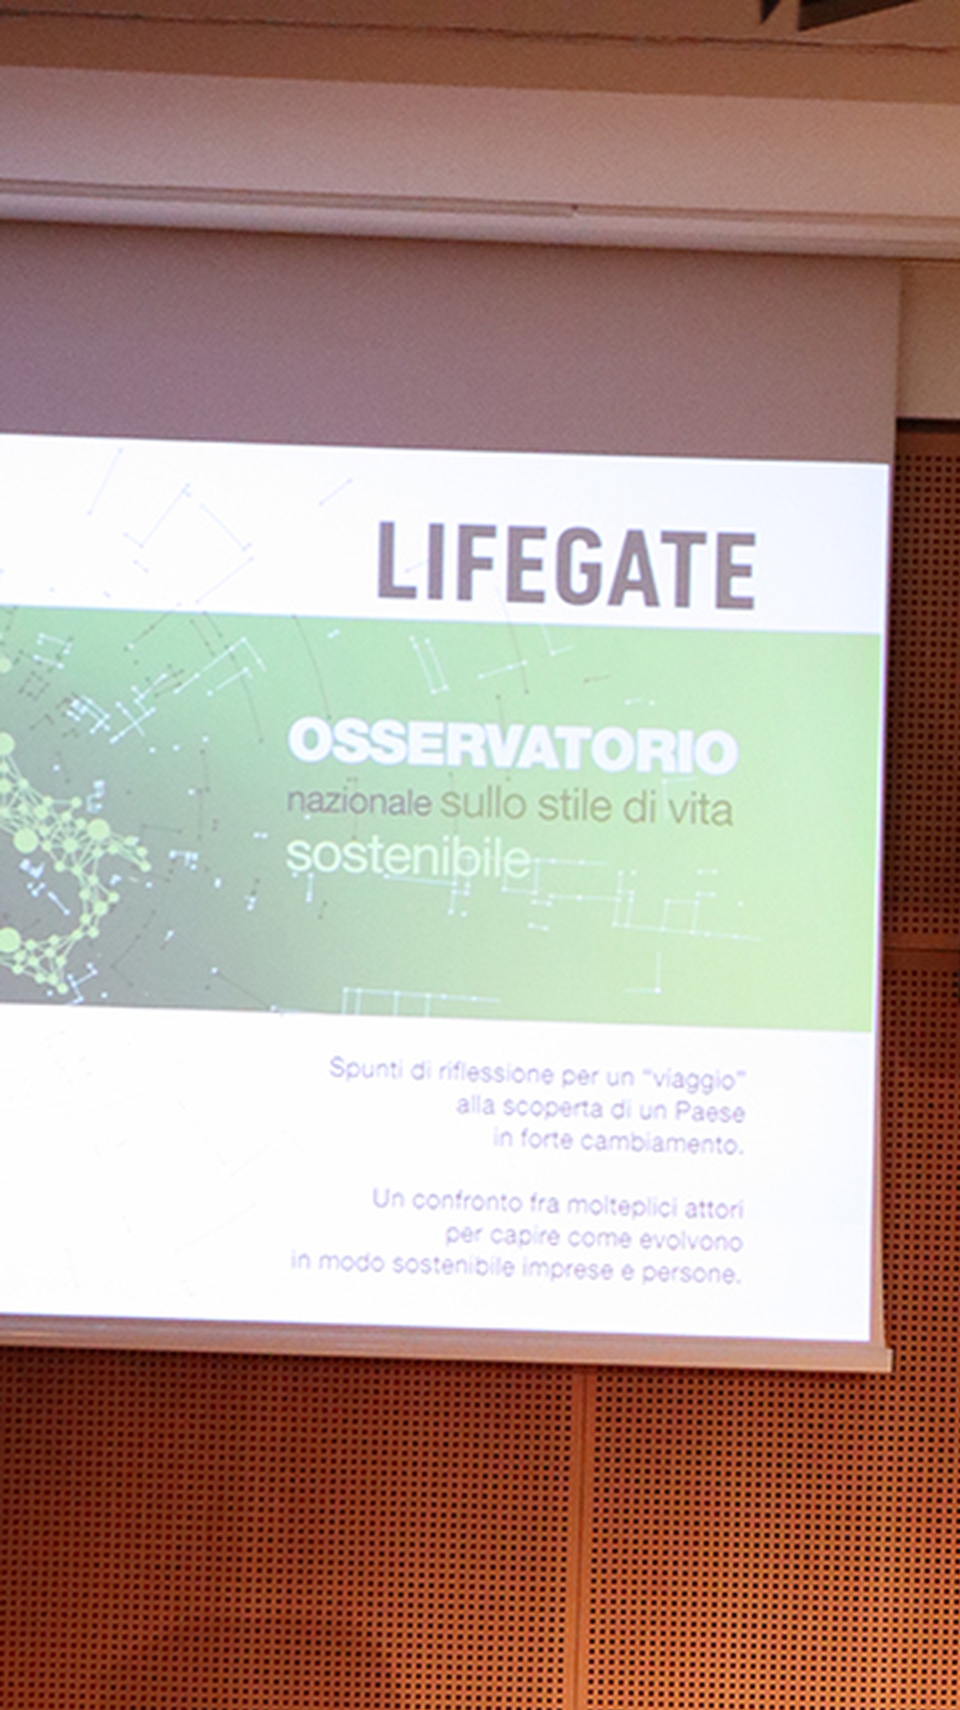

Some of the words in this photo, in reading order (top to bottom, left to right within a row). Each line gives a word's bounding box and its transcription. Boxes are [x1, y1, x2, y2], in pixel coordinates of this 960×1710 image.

[377, 521, 757, 611] LIFEGATE
[287, 716, 740, 776] OSSERVATORIO
[287, 788, 432, 817] nazionale
[440, 785, 527, 819] sullo
[537, 788, 612, 822] stile
[624, 792, 657, 824] di
[667, 792, 733, 827] vita
[286, 833, 531, 879] sostenibile
[329, 1056, 403, 1082] Spunti
[410, 1060, 432, 1082] di
[438, 1062, 554, 1085] riflessione
[561, 1067, 599, 1088] per
[606, 1068, 635, 1088] un
[456, 1095, 496, 1115] alla
[502, 1097, 603, 1120] scoperta
[611, 1100, 631, 1120] di
[639, 1102, 667, 1122] un
[675, 1099, 746, 1124] Paese
[493, 1128, 513, 1148] in
[520, 1129, 574, 1151] forte
[581, 1131, 745, 1156] cambiamento.
[372, 1188, 405, 1210] Un
[412, 1190, 523, 1212] confronto
[530, 1193, 560, 1213] fra
[567, 1196, 678, 1220] molteplici
[684, 1199, 744, 1219] attori
[446, 1225, 483, 1246] per
[490, 1226, 560, 1250] capire
[567, 1229, 632, 1249] come
[639, 1231, 744, 1253] evolvono
[291, 1250, 311, 1270] in
[319, 1253, 385, 1272] modo
[392, 1254, 516, 1278] sostenibile
[522, 1260, 613, 1282] imprese
[620, 1265, 635, 1281] e
[642, 1264, 742, 1286] persone.
